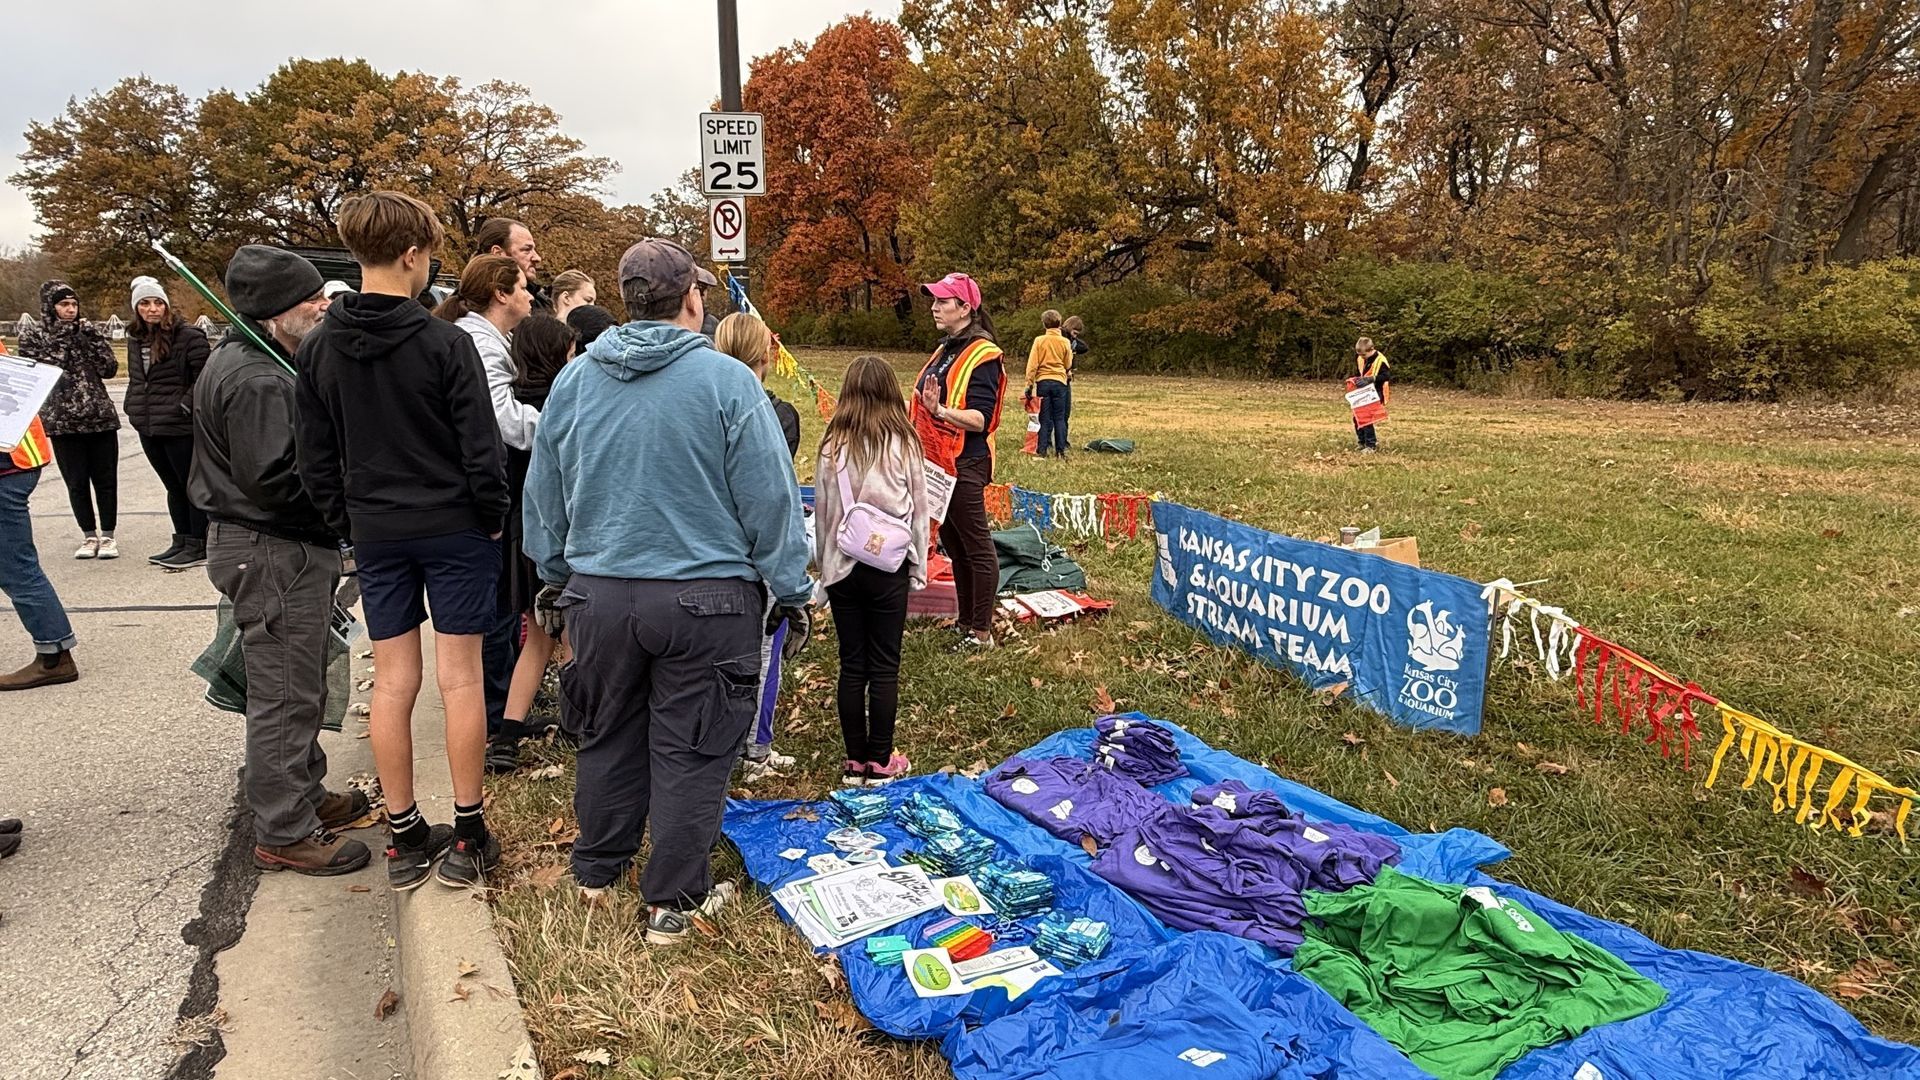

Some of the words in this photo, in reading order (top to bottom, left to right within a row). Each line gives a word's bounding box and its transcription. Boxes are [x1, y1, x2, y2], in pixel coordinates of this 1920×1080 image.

[706, 119, 757, 135] SPEED
[714, 139, 752, 155] LIMIT
[709, 161, 759, 190] 25
[1179, 525, 1251, 573] KANSAS
[1250, 555, 1316, 593] CITY
[1317, 568, 1391, 615] ZOO
[1267, 627, 1354, 680] TEAM
[1400, 674, 1458, 709] ZOO
[1437, 674, 1459, 692] City
